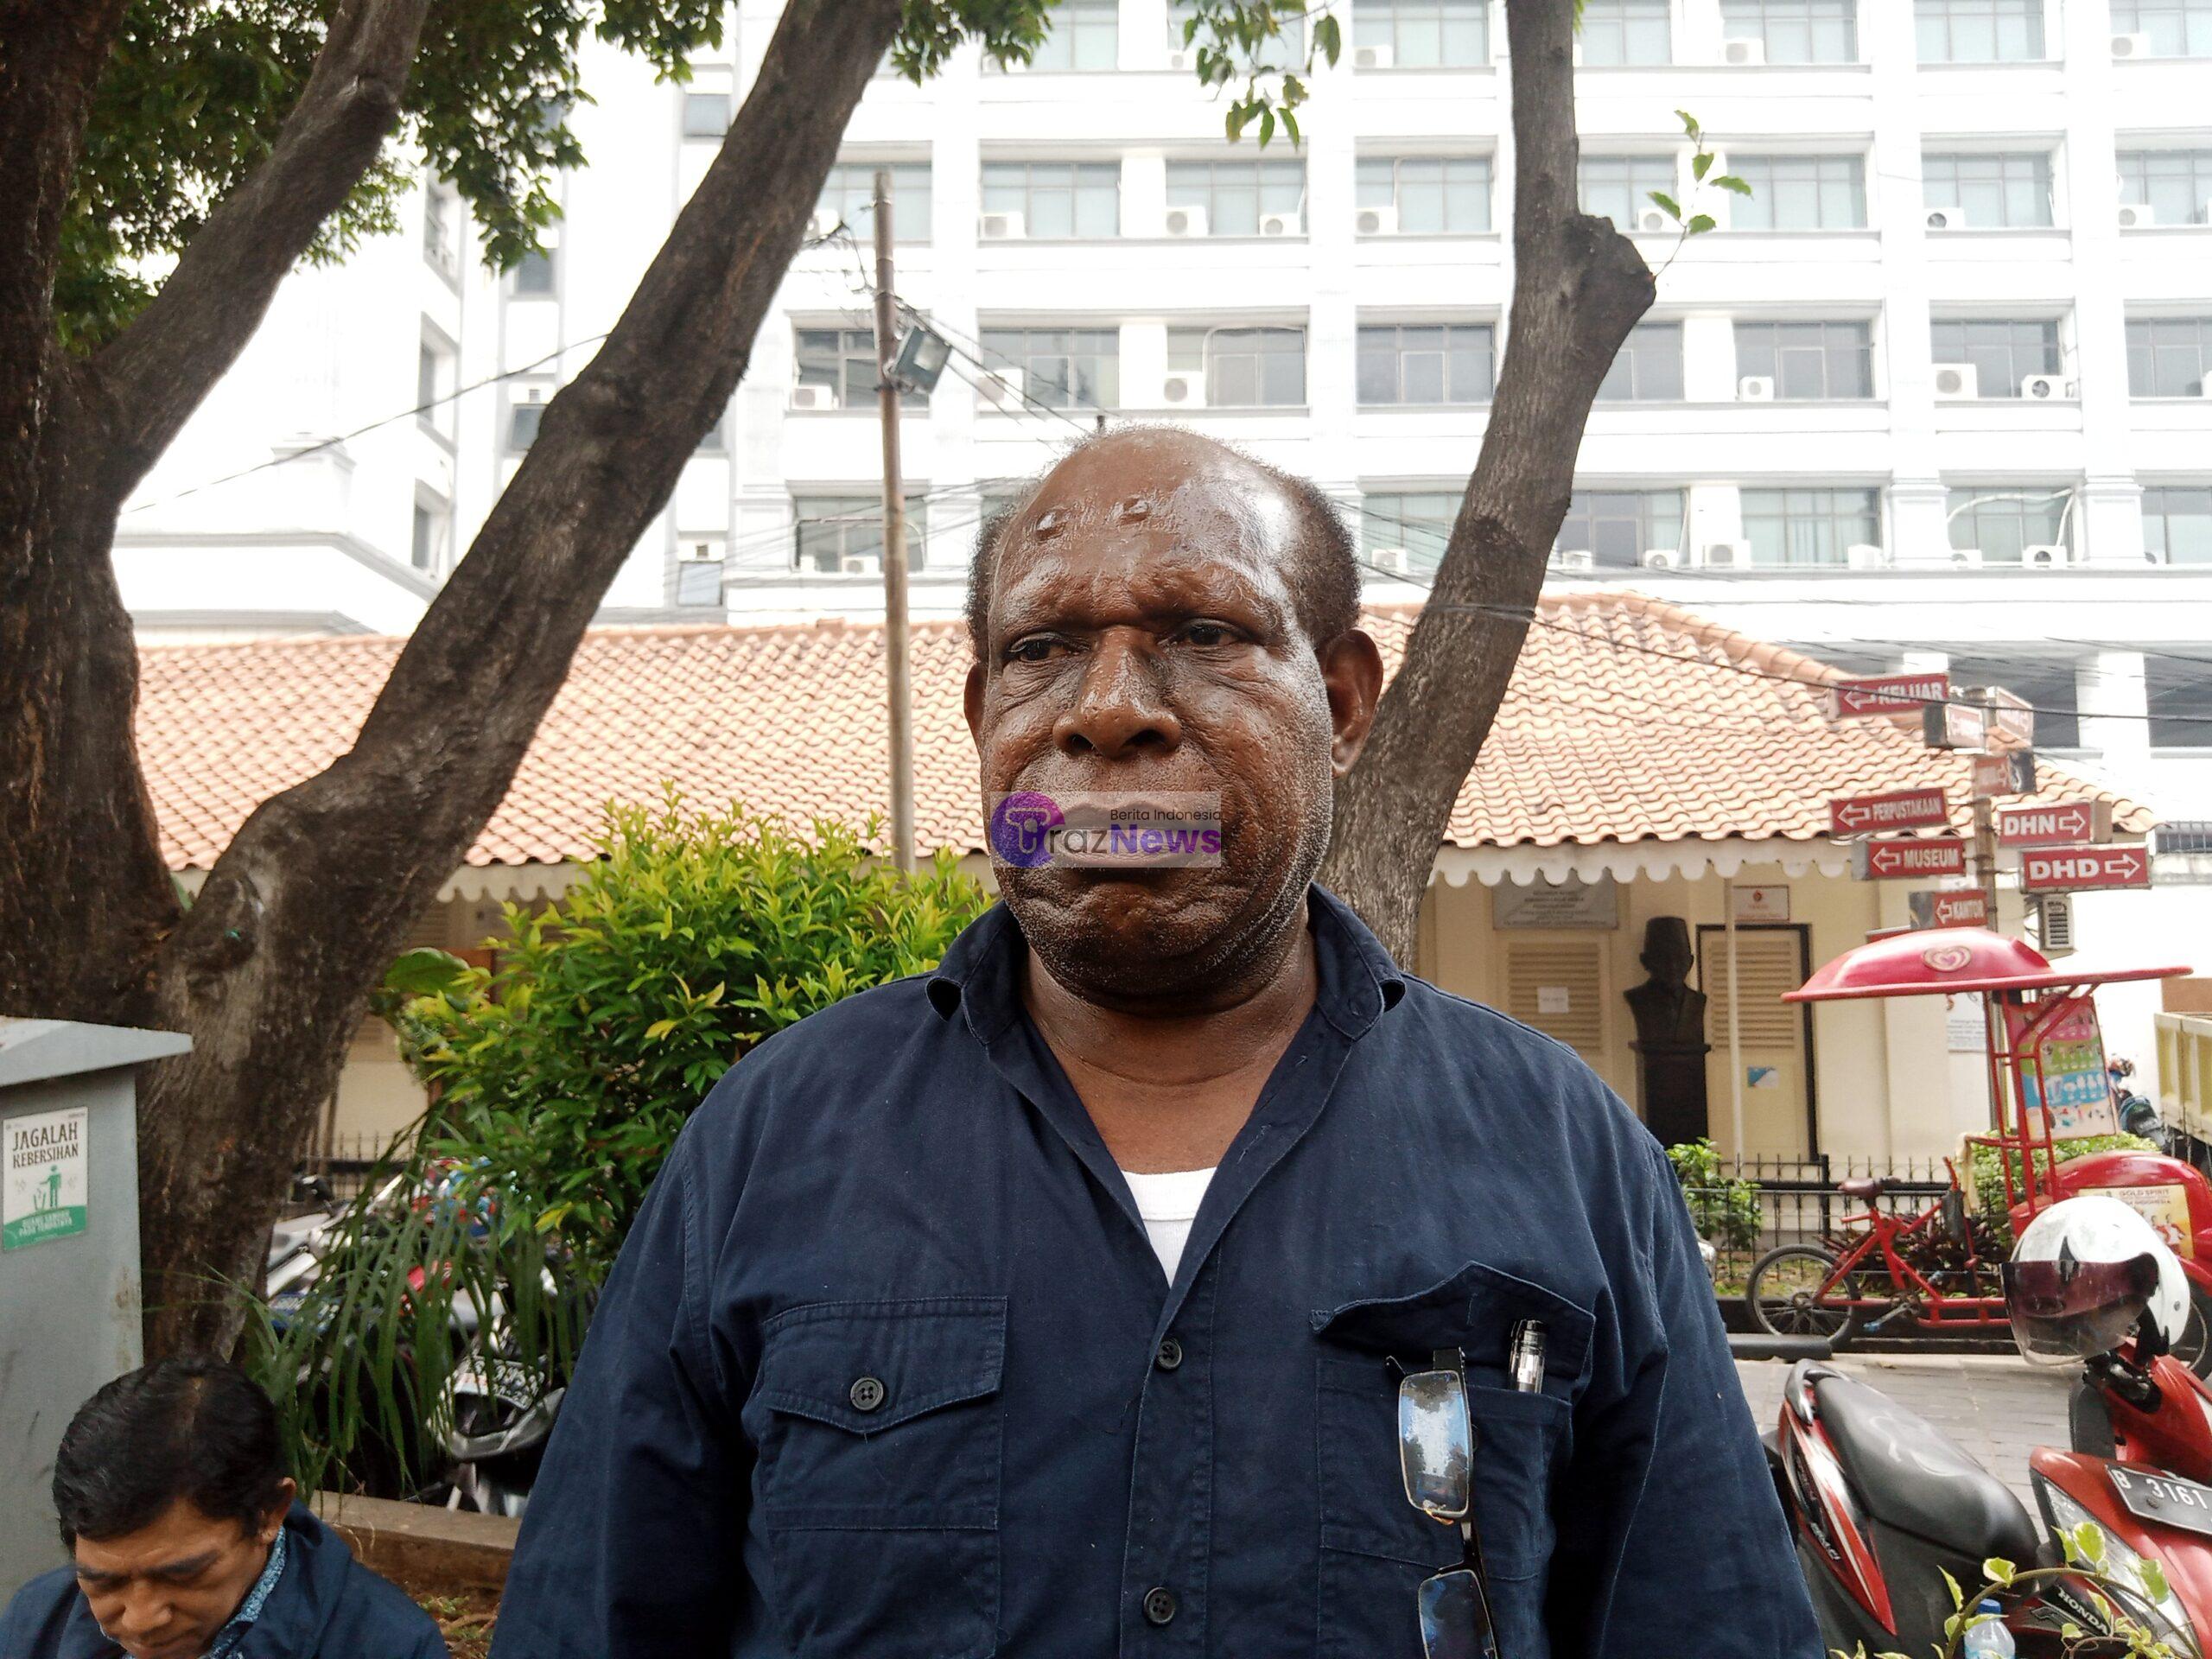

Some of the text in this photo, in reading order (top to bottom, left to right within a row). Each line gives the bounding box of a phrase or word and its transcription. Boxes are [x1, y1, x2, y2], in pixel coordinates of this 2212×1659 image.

[1878, 682, 1944, 704] KELUAR
[1872, 797, 1942, 821] PERPUSTAKAAN
[2004, 814, 2056, 836] DHN
[1904, 848, 1959, 868] MUSEUM
[2029, 858, 2100, 880] DHD
[13, 1122, 77, 1152] JAGALAH
[13, 1142, 79, 1168] KEBERSIHAN
[2111, 1469, 2209, 1510] B 3161
[2057, 1586, 2108, 1637] HONDA
